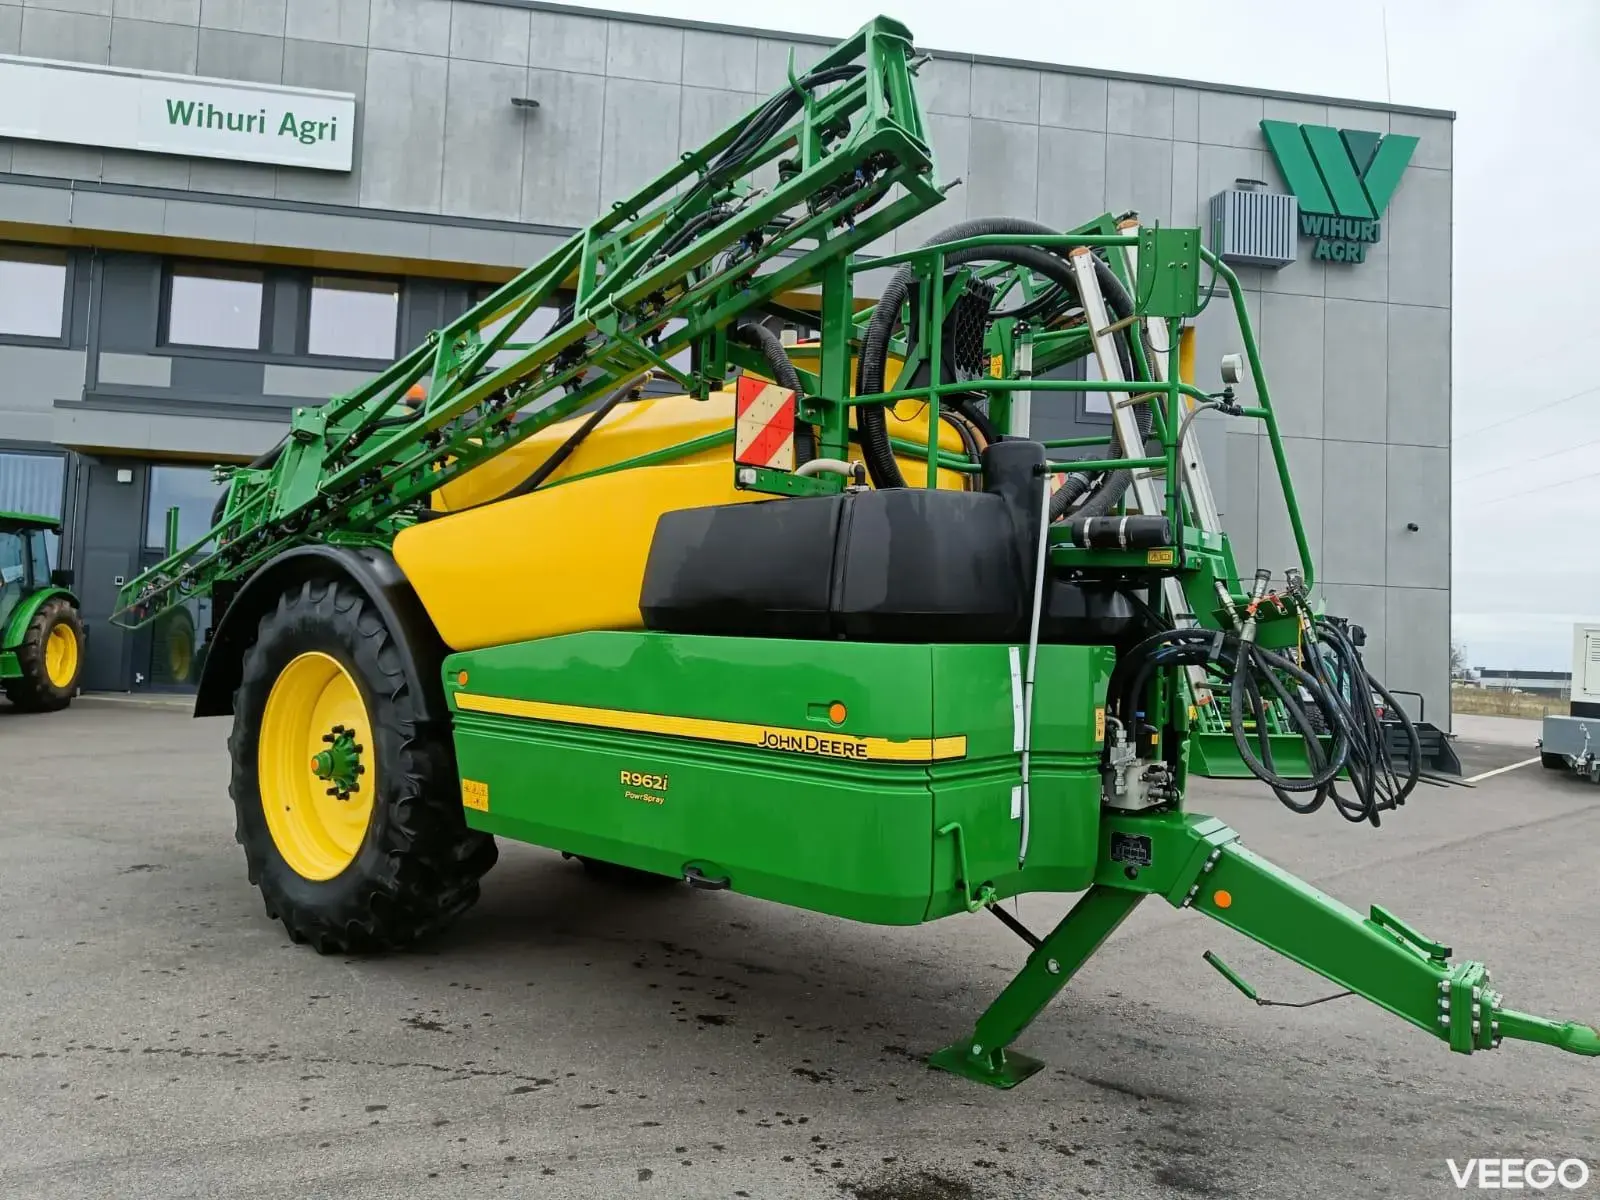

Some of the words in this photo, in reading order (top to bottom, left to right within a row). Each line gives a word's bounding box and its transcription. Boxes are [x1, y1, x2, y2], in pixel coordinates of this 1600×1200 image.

[166, 99, 265, 134] Wihuri
[278, 112, 337, 145] Agri
[1300, 214, 1380, 243] WIHURI
[1313, 238, 1368, 264] AGRI
[805, 735, 868, 758] DEERE
[620, 770, 668, 791] R962i
[624, 790, 665, 805] PowrSpray
